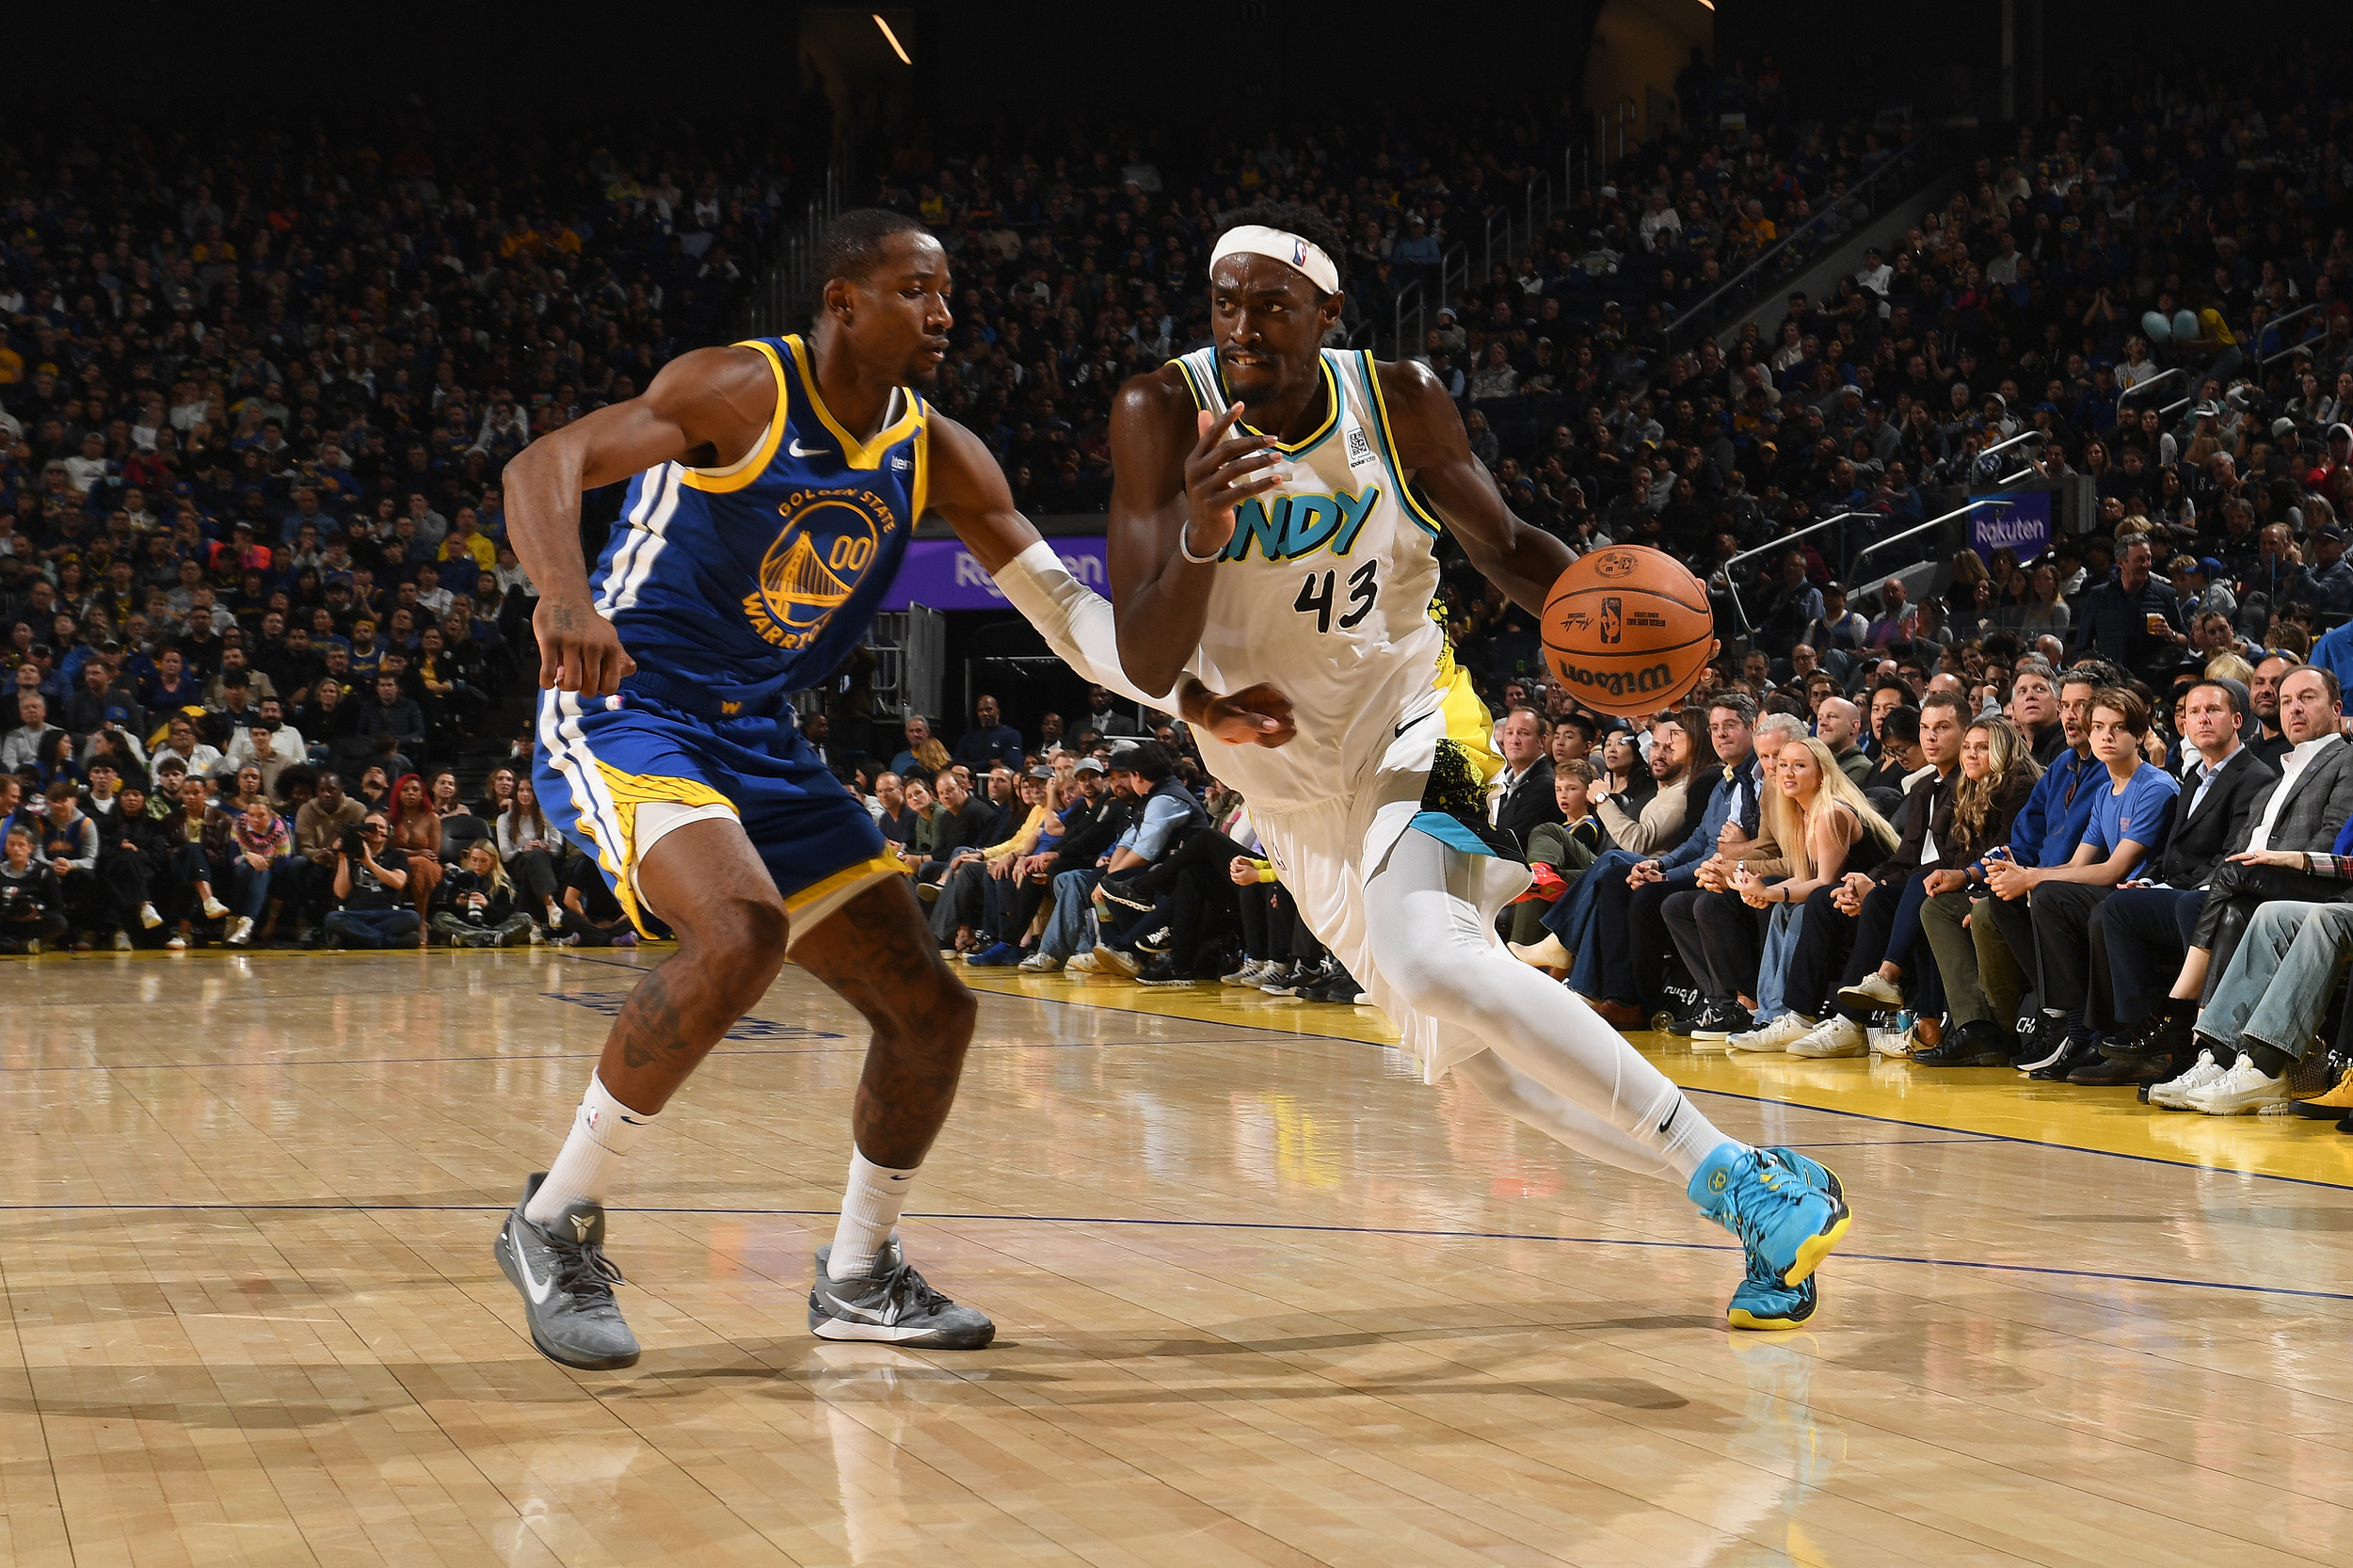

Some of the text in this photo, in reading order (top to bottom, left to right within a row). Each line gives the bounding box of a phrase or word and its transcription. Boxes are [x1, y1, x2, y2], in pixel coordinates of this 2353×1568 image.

[778, 488, 896, 534] GOLDEN STATE
[1218, 484, 1382, 563] NDY
[1976, 517, 2044, 543] Rakuten
[829, 535, 872, 571] 00
[1293, 559, 1379, 634] 43
[742, 591, 833, 650] WARRI
[1559, 659, 1675, 696] Wilson
